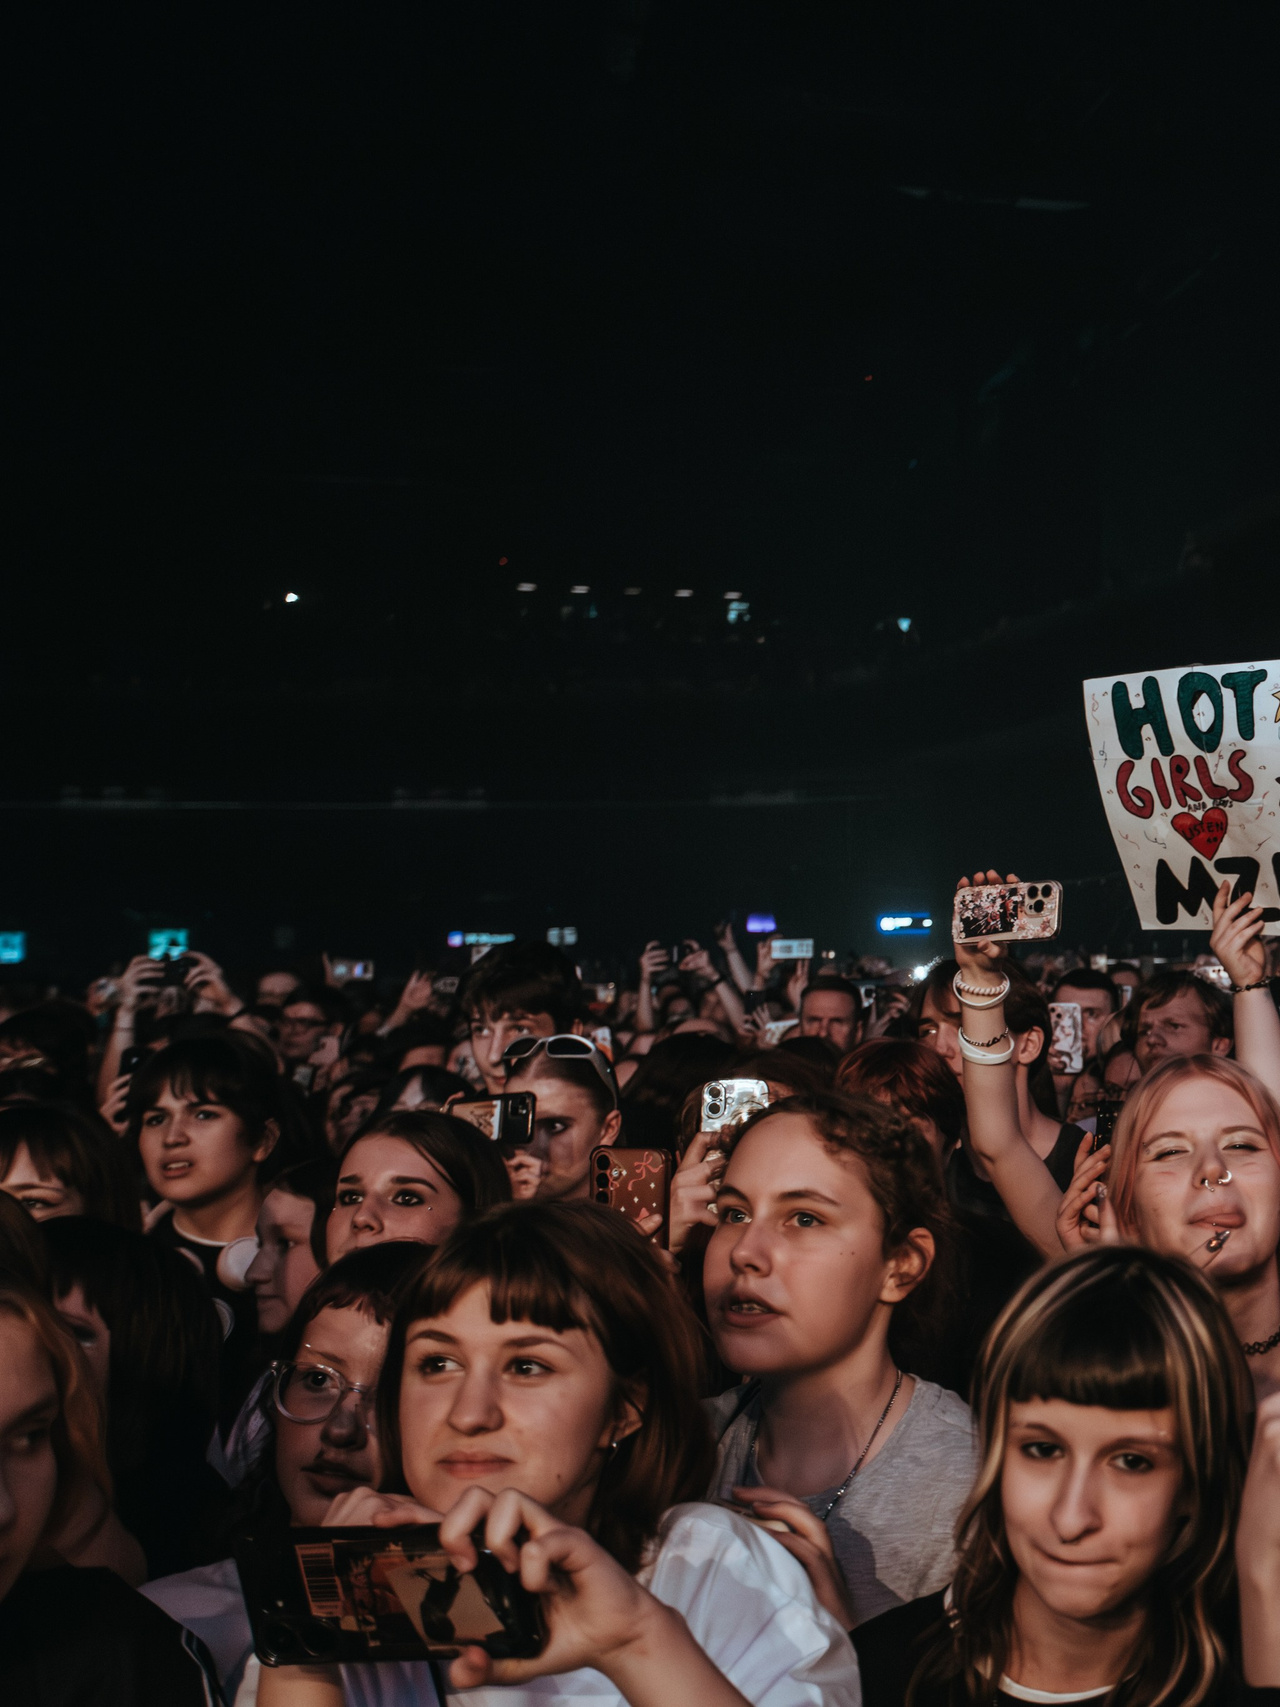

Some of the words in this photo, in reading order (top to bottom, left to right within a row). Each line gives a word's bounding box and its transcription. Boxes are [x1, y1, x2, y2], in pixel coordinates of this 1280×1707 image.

[1111, 669, 1268, 760] HOT
[1116, 749, 1255, 819] GIRLS
[1182, 821, 1224, 840] LISTEN
